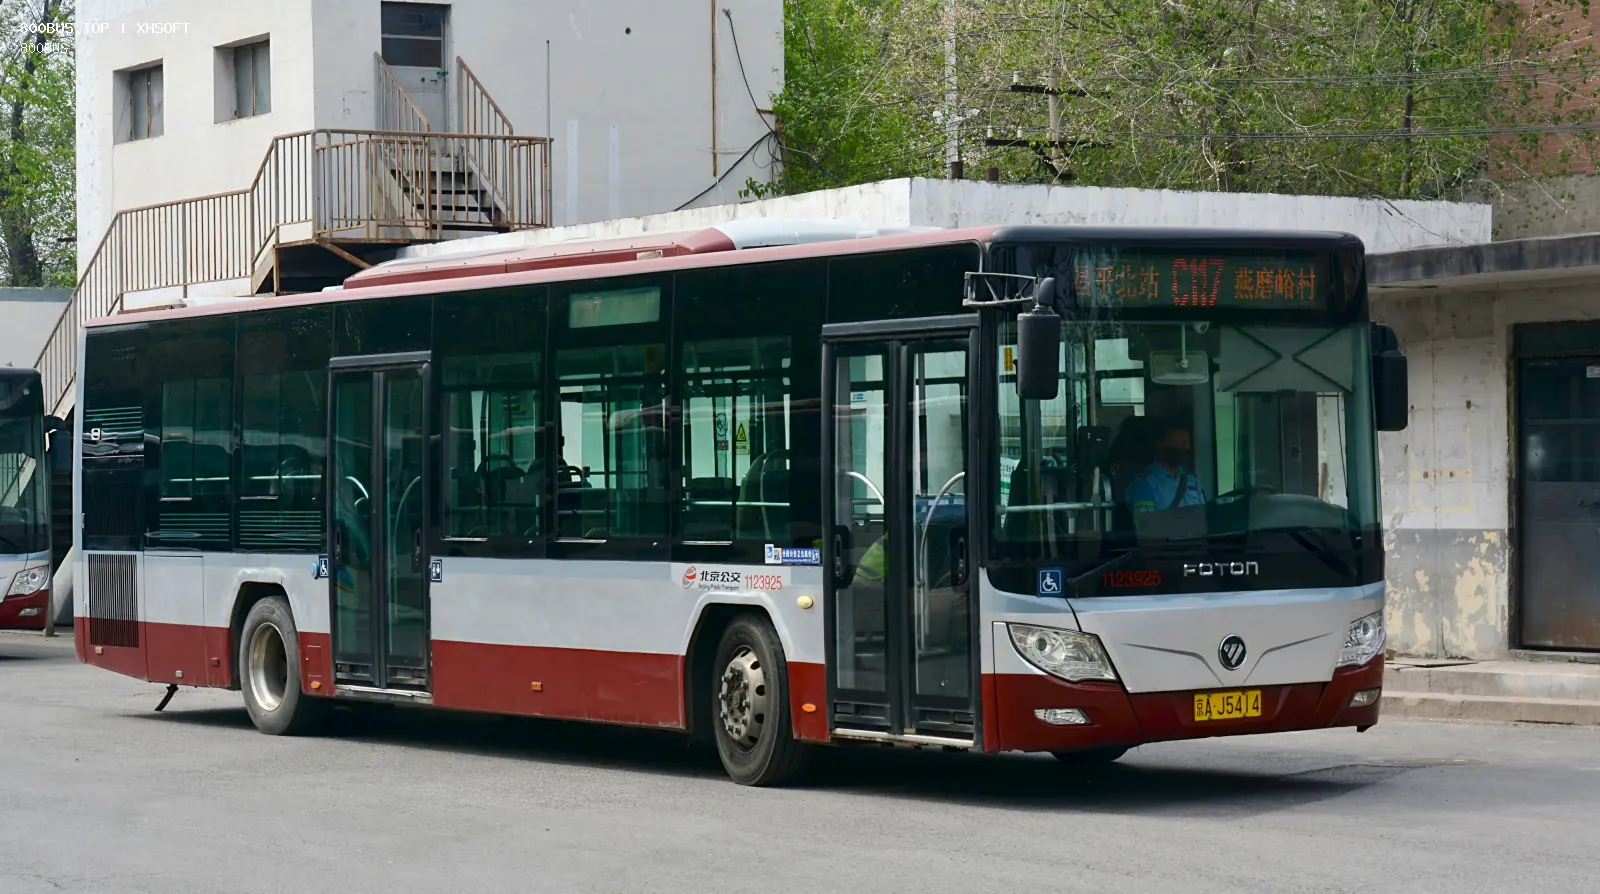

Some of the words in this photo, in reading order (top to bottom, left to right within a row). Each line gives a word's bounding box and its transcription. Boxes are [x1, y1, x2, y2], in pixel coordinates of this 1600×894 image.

[699, 570, 741, 583] 北京公交
[1183, 561, 1259, 577] FOTON
[744, 575, 783, 590] 1123925
[1101, 570, 1162, 588] 1123925
